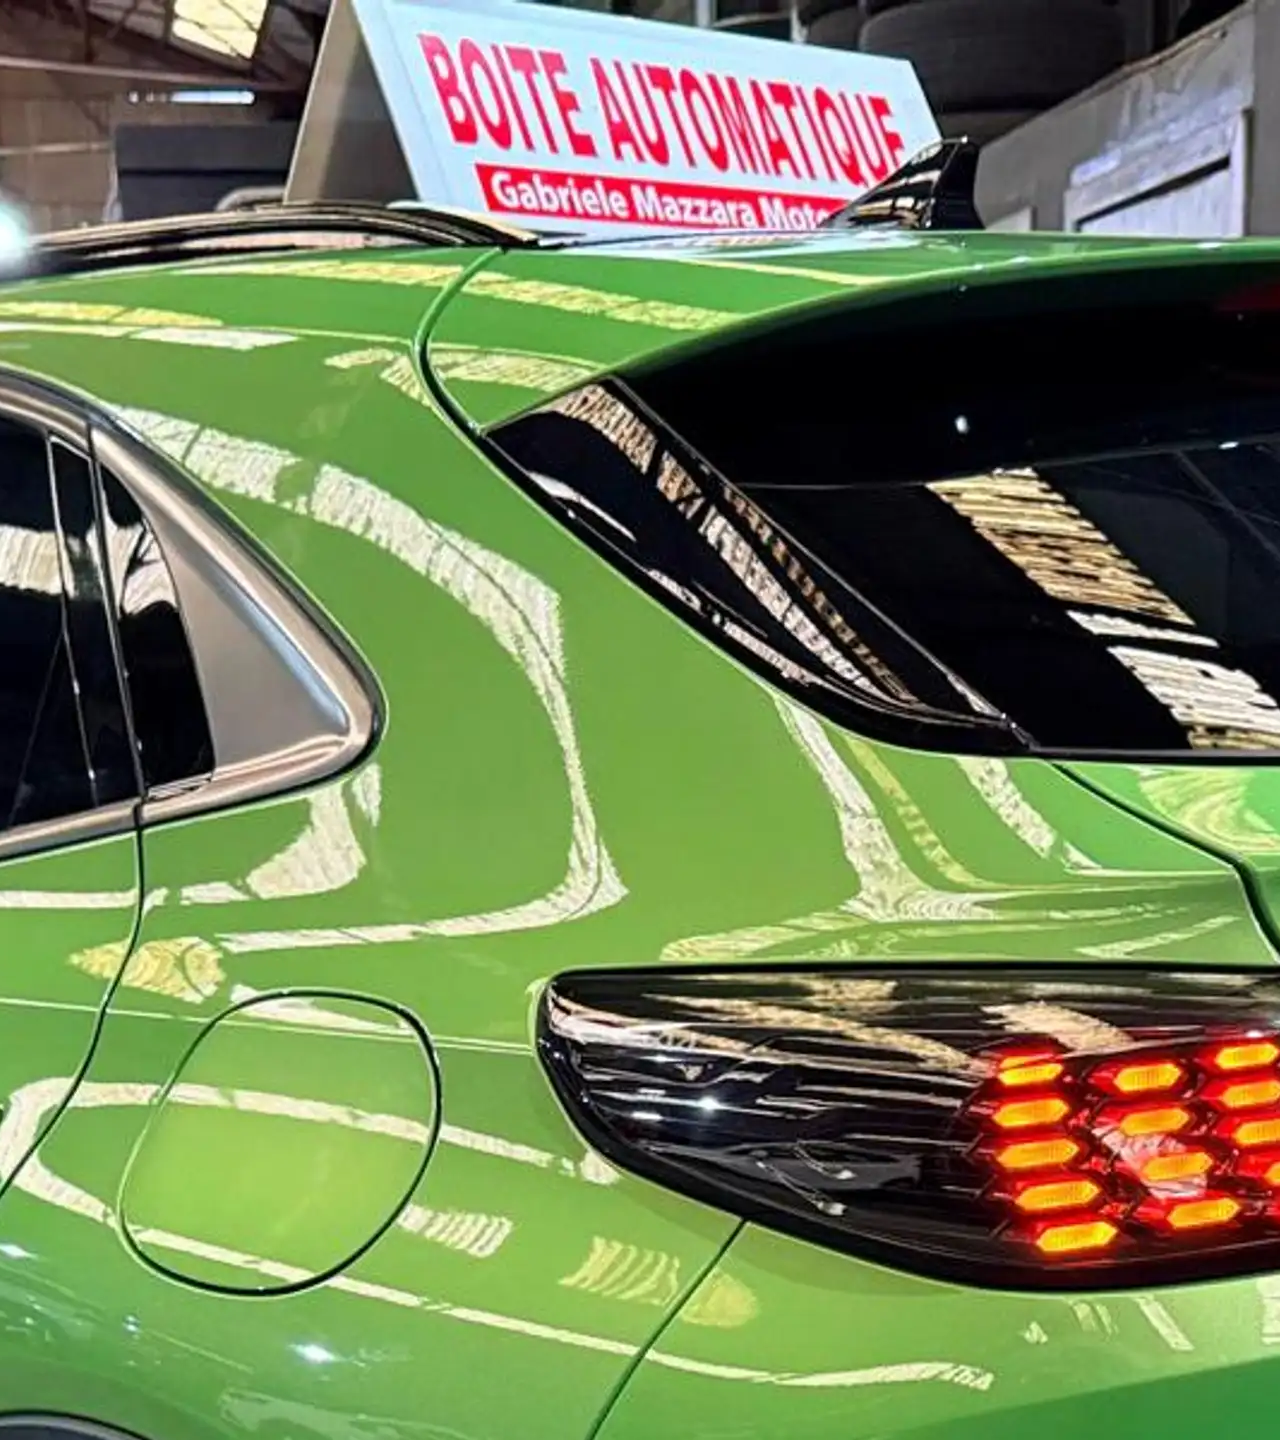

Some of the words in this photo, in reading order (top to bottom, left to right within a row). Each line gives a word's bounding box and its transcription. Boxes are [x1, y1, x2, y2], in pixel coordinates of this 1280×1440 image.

[417, 33, 598, 157] BOITE
[589, 57, 905, 187] AUTOMATIQUE
[490, 171, 629, 218] Gabriele
[630, 184, 759, 228] Mazzara
